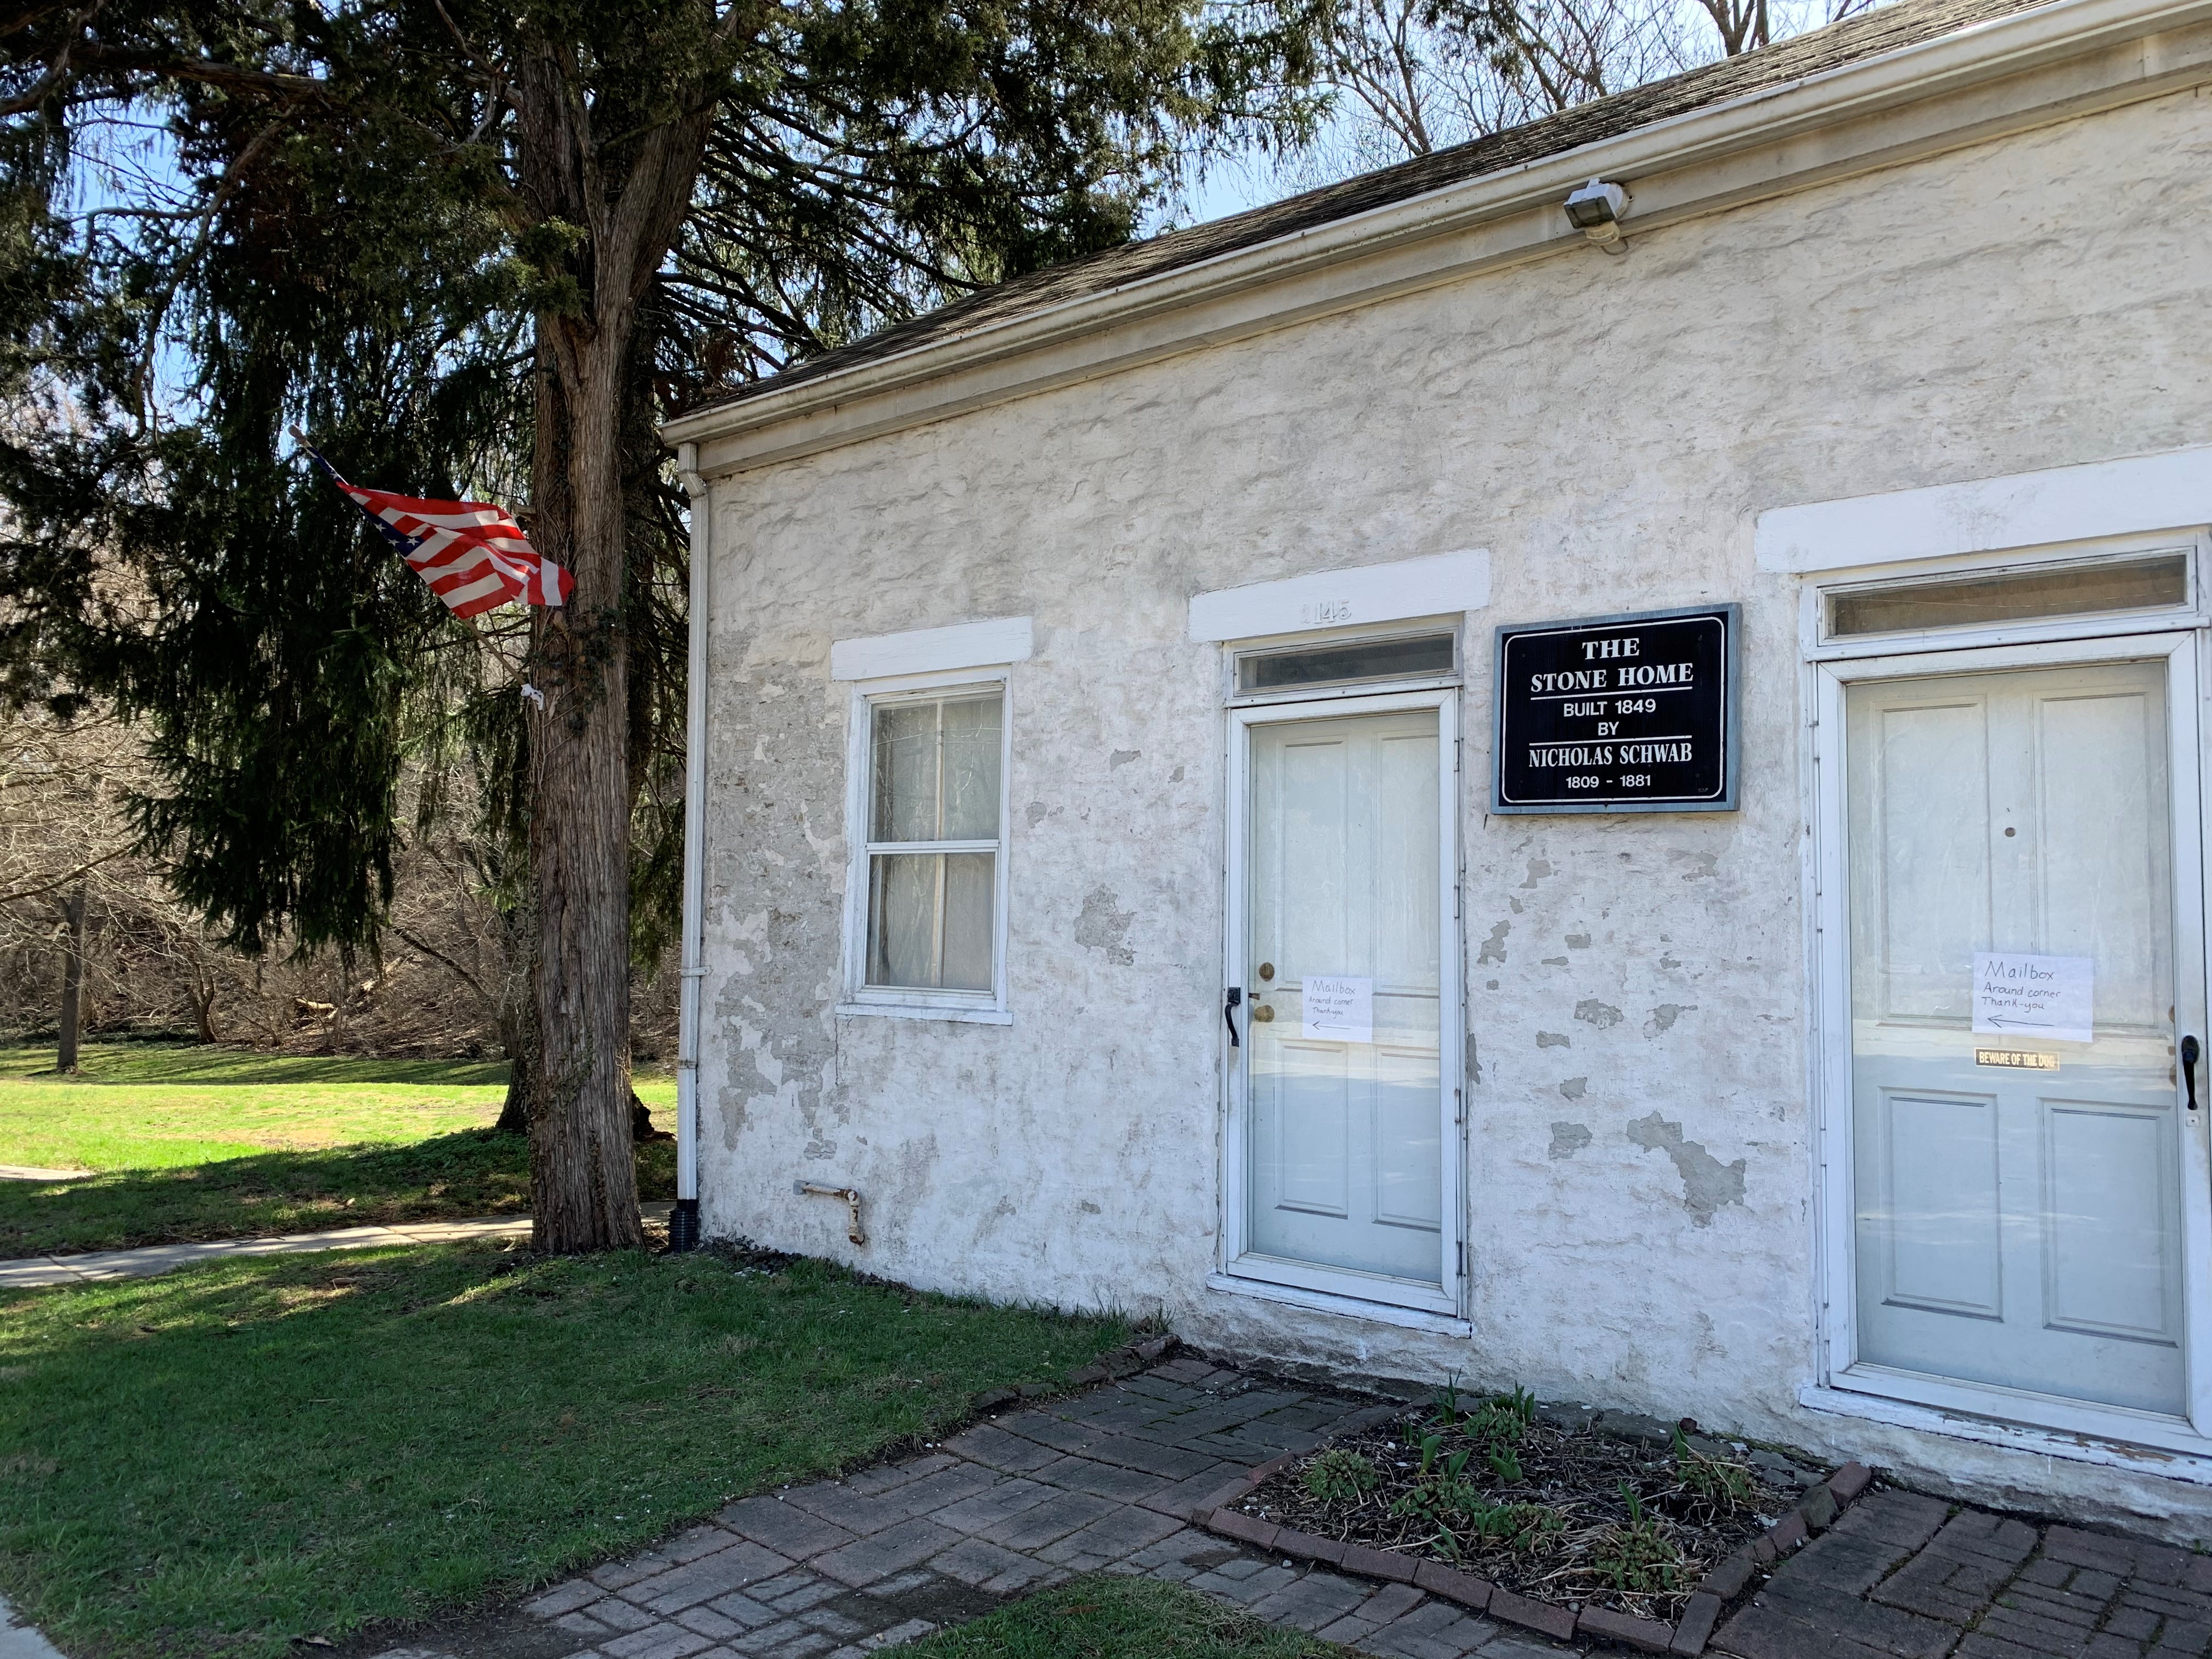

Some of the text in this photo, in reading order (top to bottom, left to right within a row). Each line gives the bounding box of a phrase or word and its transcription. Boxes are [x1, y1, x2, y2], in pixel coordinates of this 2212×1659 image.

[1300, 599, 1352, 624] 2145
[1582, 637, 1640, 660] THE
[1531, 663, 1694, 692] STONE HOME
[1564, 698, 1656, 717] BUILT 1849
[1598, 721, 1619, 736] BY
[1529, 743, 1692, 768] NICHOLAS SCHWAB
[1566, 776, 1599, 788] 1809
[1620, 775, 1651, 787] 1881
[1985, 961, 2054, 980] Mailbox
[1311, 980, 1356, 995] Mailbox
[1983, 981, 2062, 998] Around corner
[1308, 996, 1331, 1005] Around
[1979, 1052, 2055, 1067] BEWARE OF THE DOG
